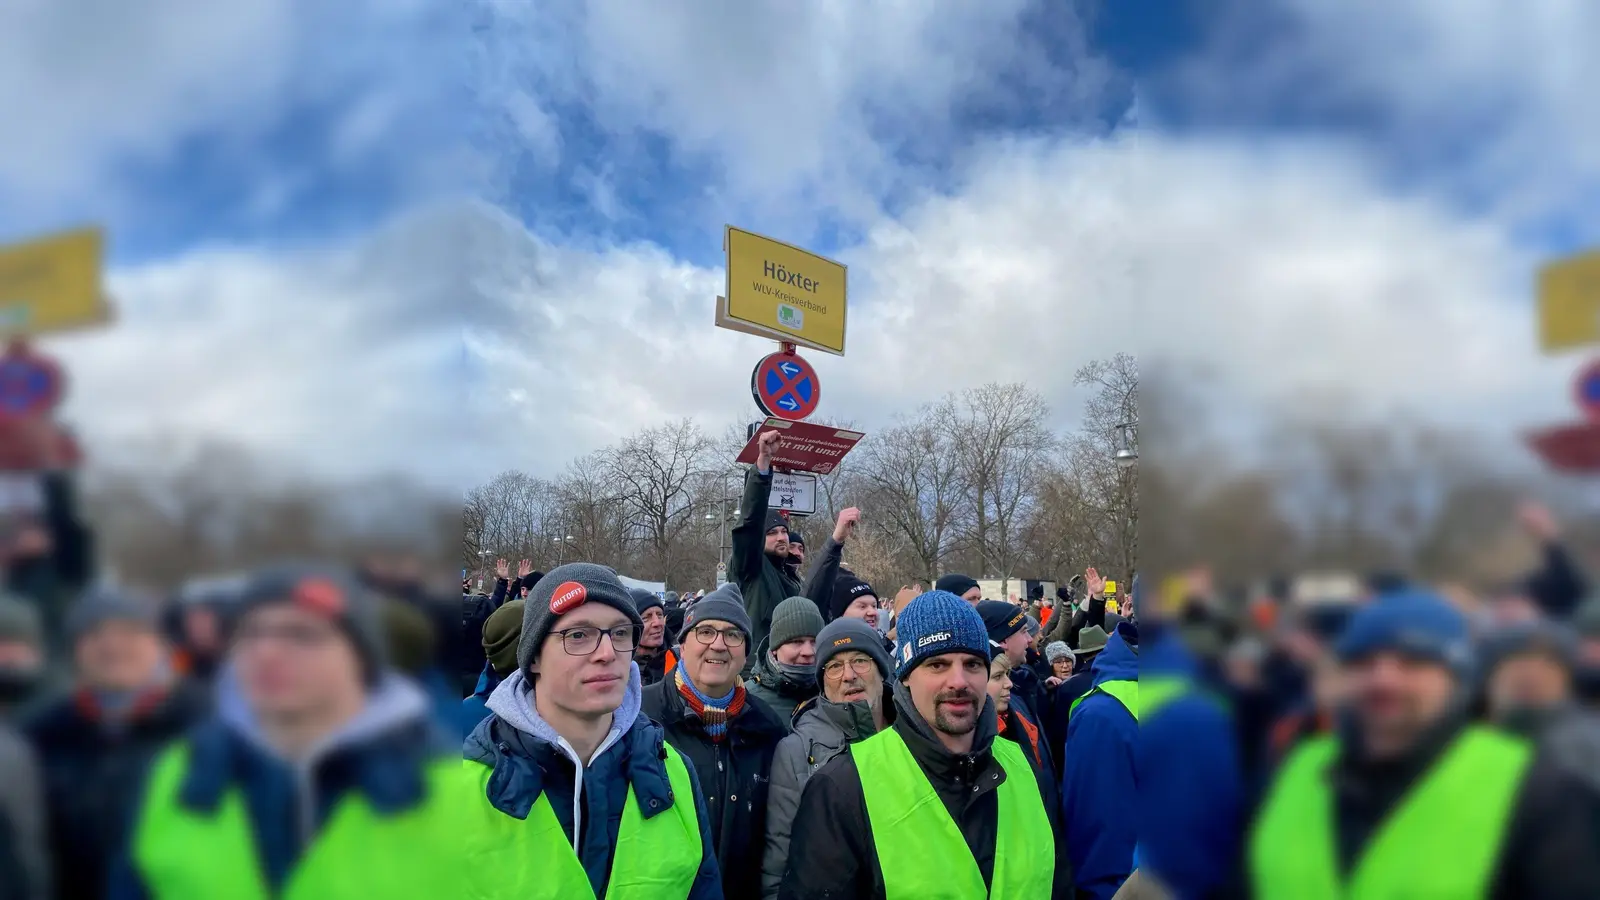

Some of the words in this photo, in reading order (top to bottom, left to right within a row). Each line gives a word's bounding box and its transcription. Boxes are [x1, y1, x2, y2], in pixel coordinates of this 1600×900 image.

[764, 260, 819, 293] Höxter
[753, 282, 827, 314] WLV-Kreisverband
[780, 440, 792, 449] ht
[793, 444, 814, 452] mit
[815, 448, 842, 457] uns!
[553, 587, 582, 608] AUTOFIT
[918, 631, 951, 647] Eisbär
